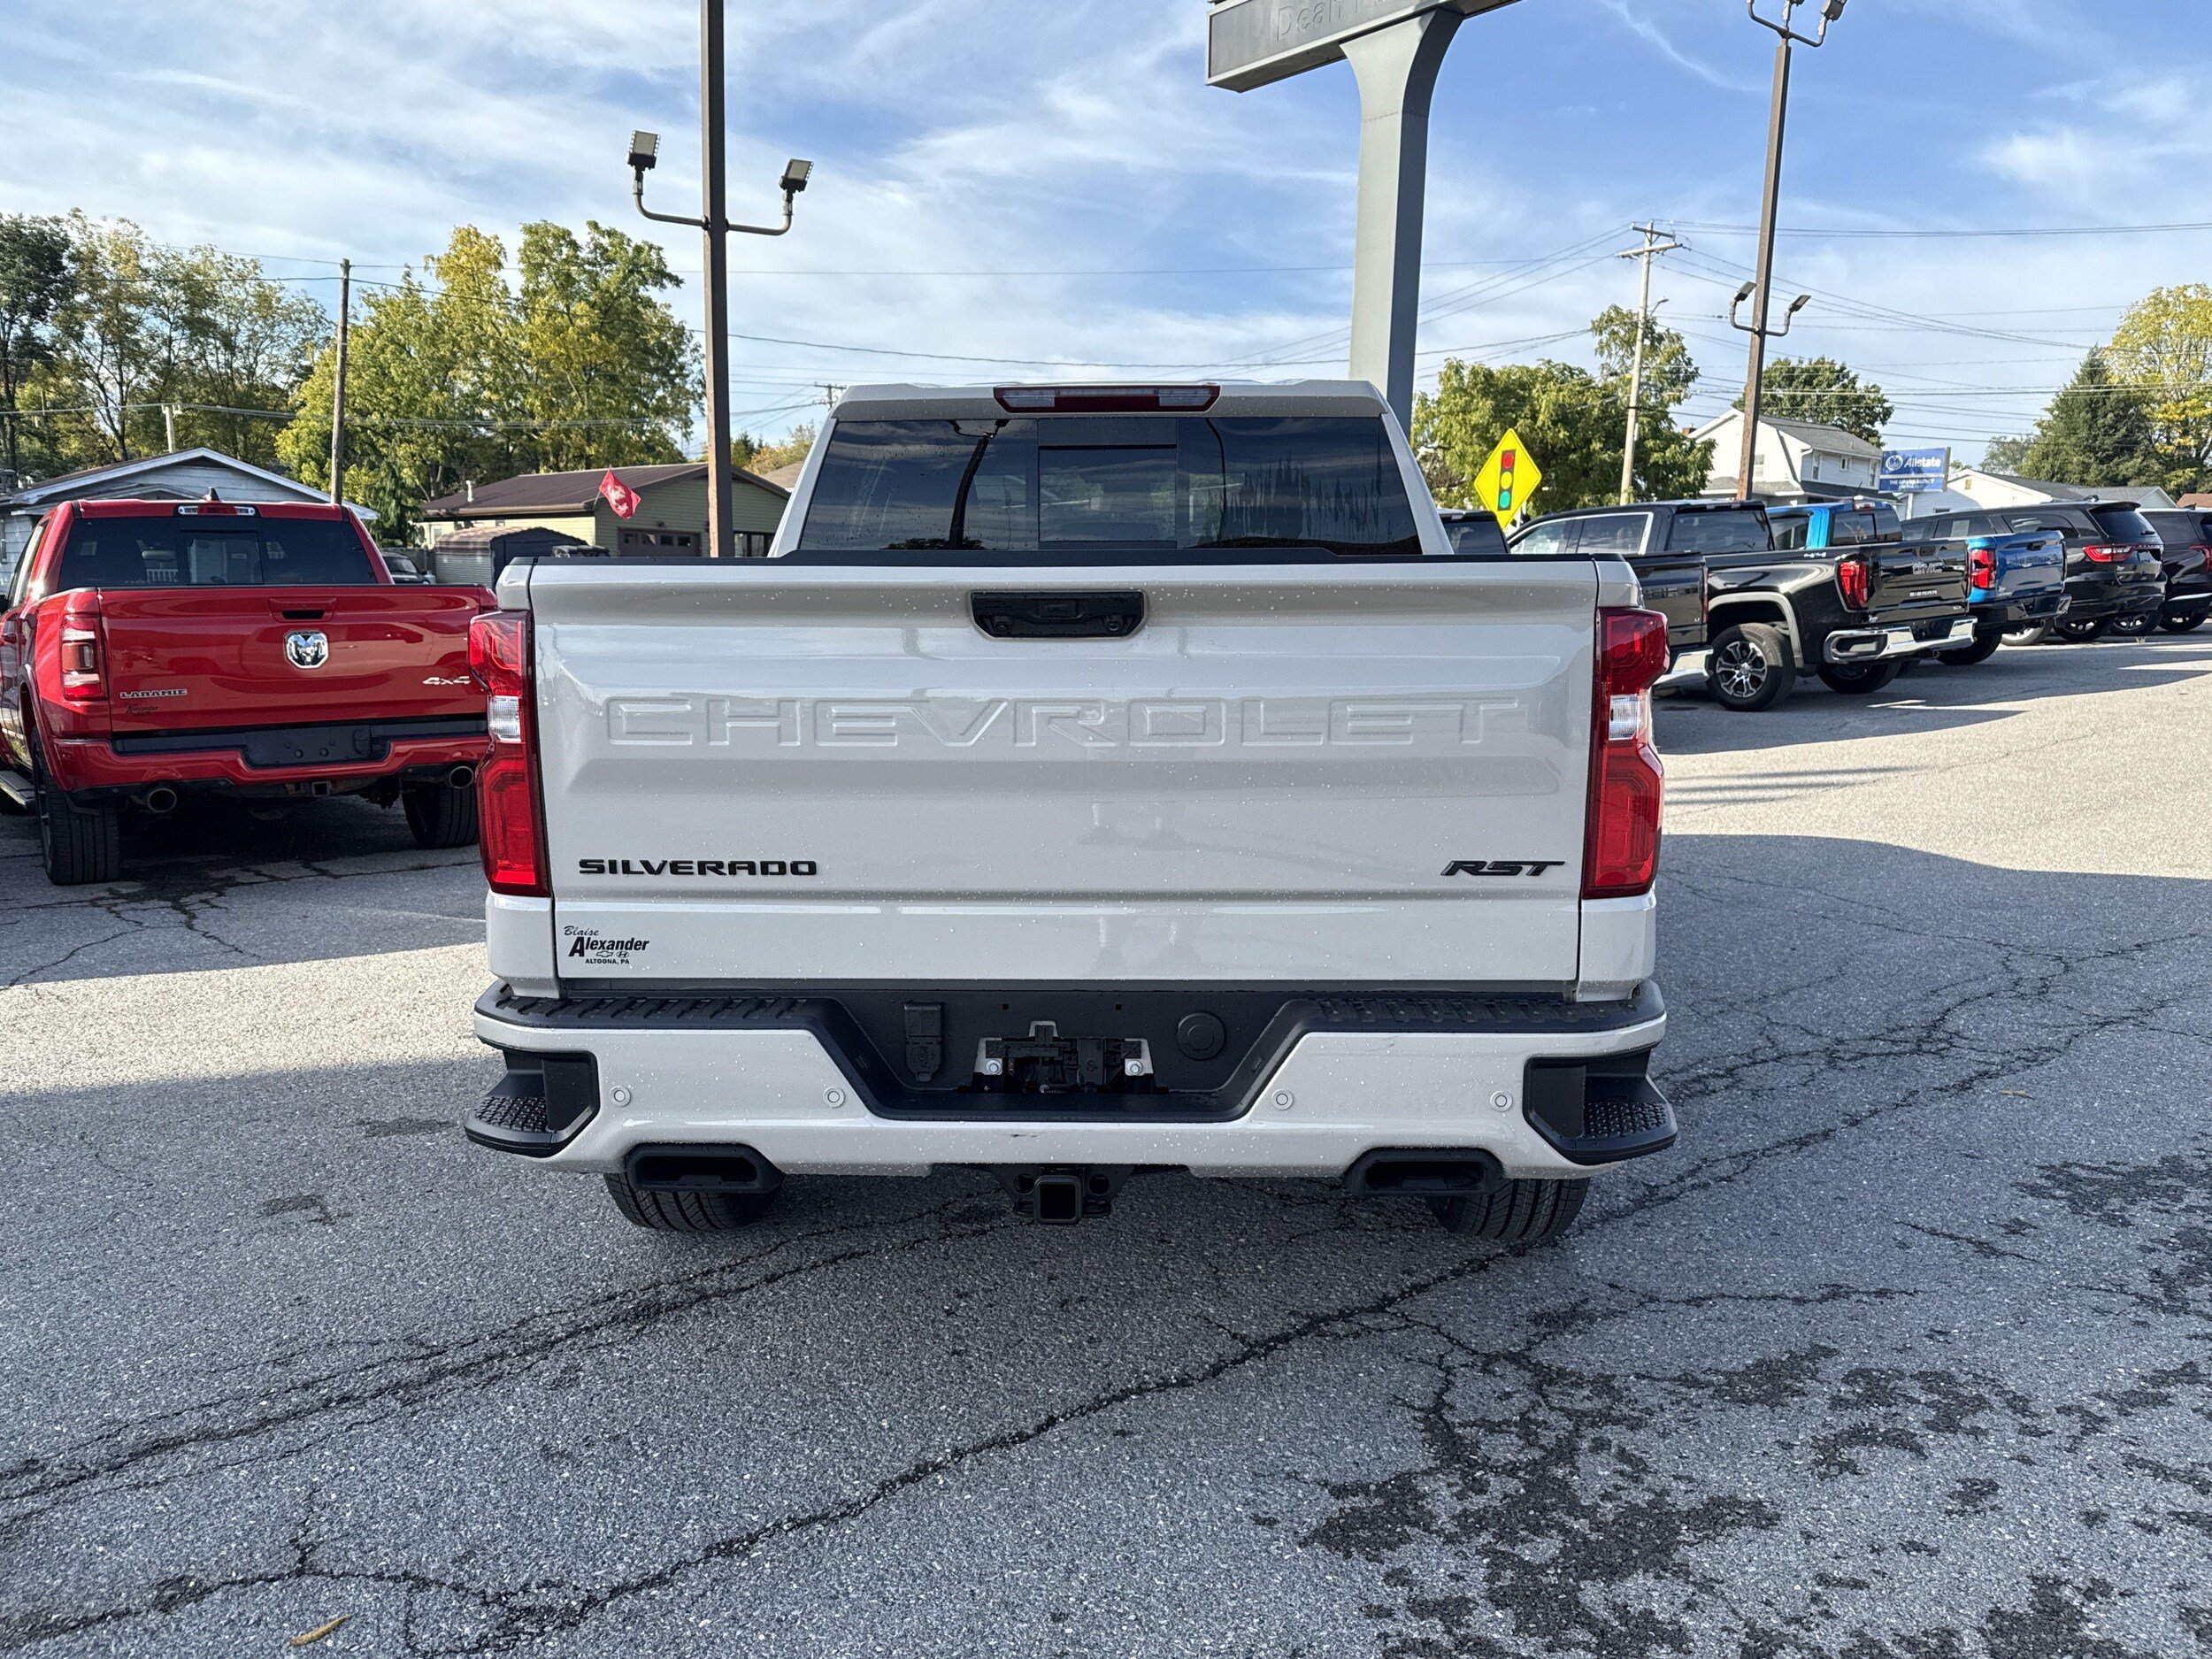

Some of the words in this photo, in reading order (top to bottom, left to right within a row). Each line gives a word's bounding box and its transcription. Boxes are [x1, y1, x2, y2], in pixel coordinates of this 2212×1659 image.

[1903, 457, 1942, 468] Allstate
[1912, 562, 1943, 575] GMC
[119, 689, 188, 699] LARAMIE
[603, 695, 1519, 747] CHEVROLET
[579, 858, 817, 876] SILVERADO
[1440, 860, 1565, 876] RST
[564, 925, 600, 936] Blaise
[568, 936, 650, 957] Alexander
